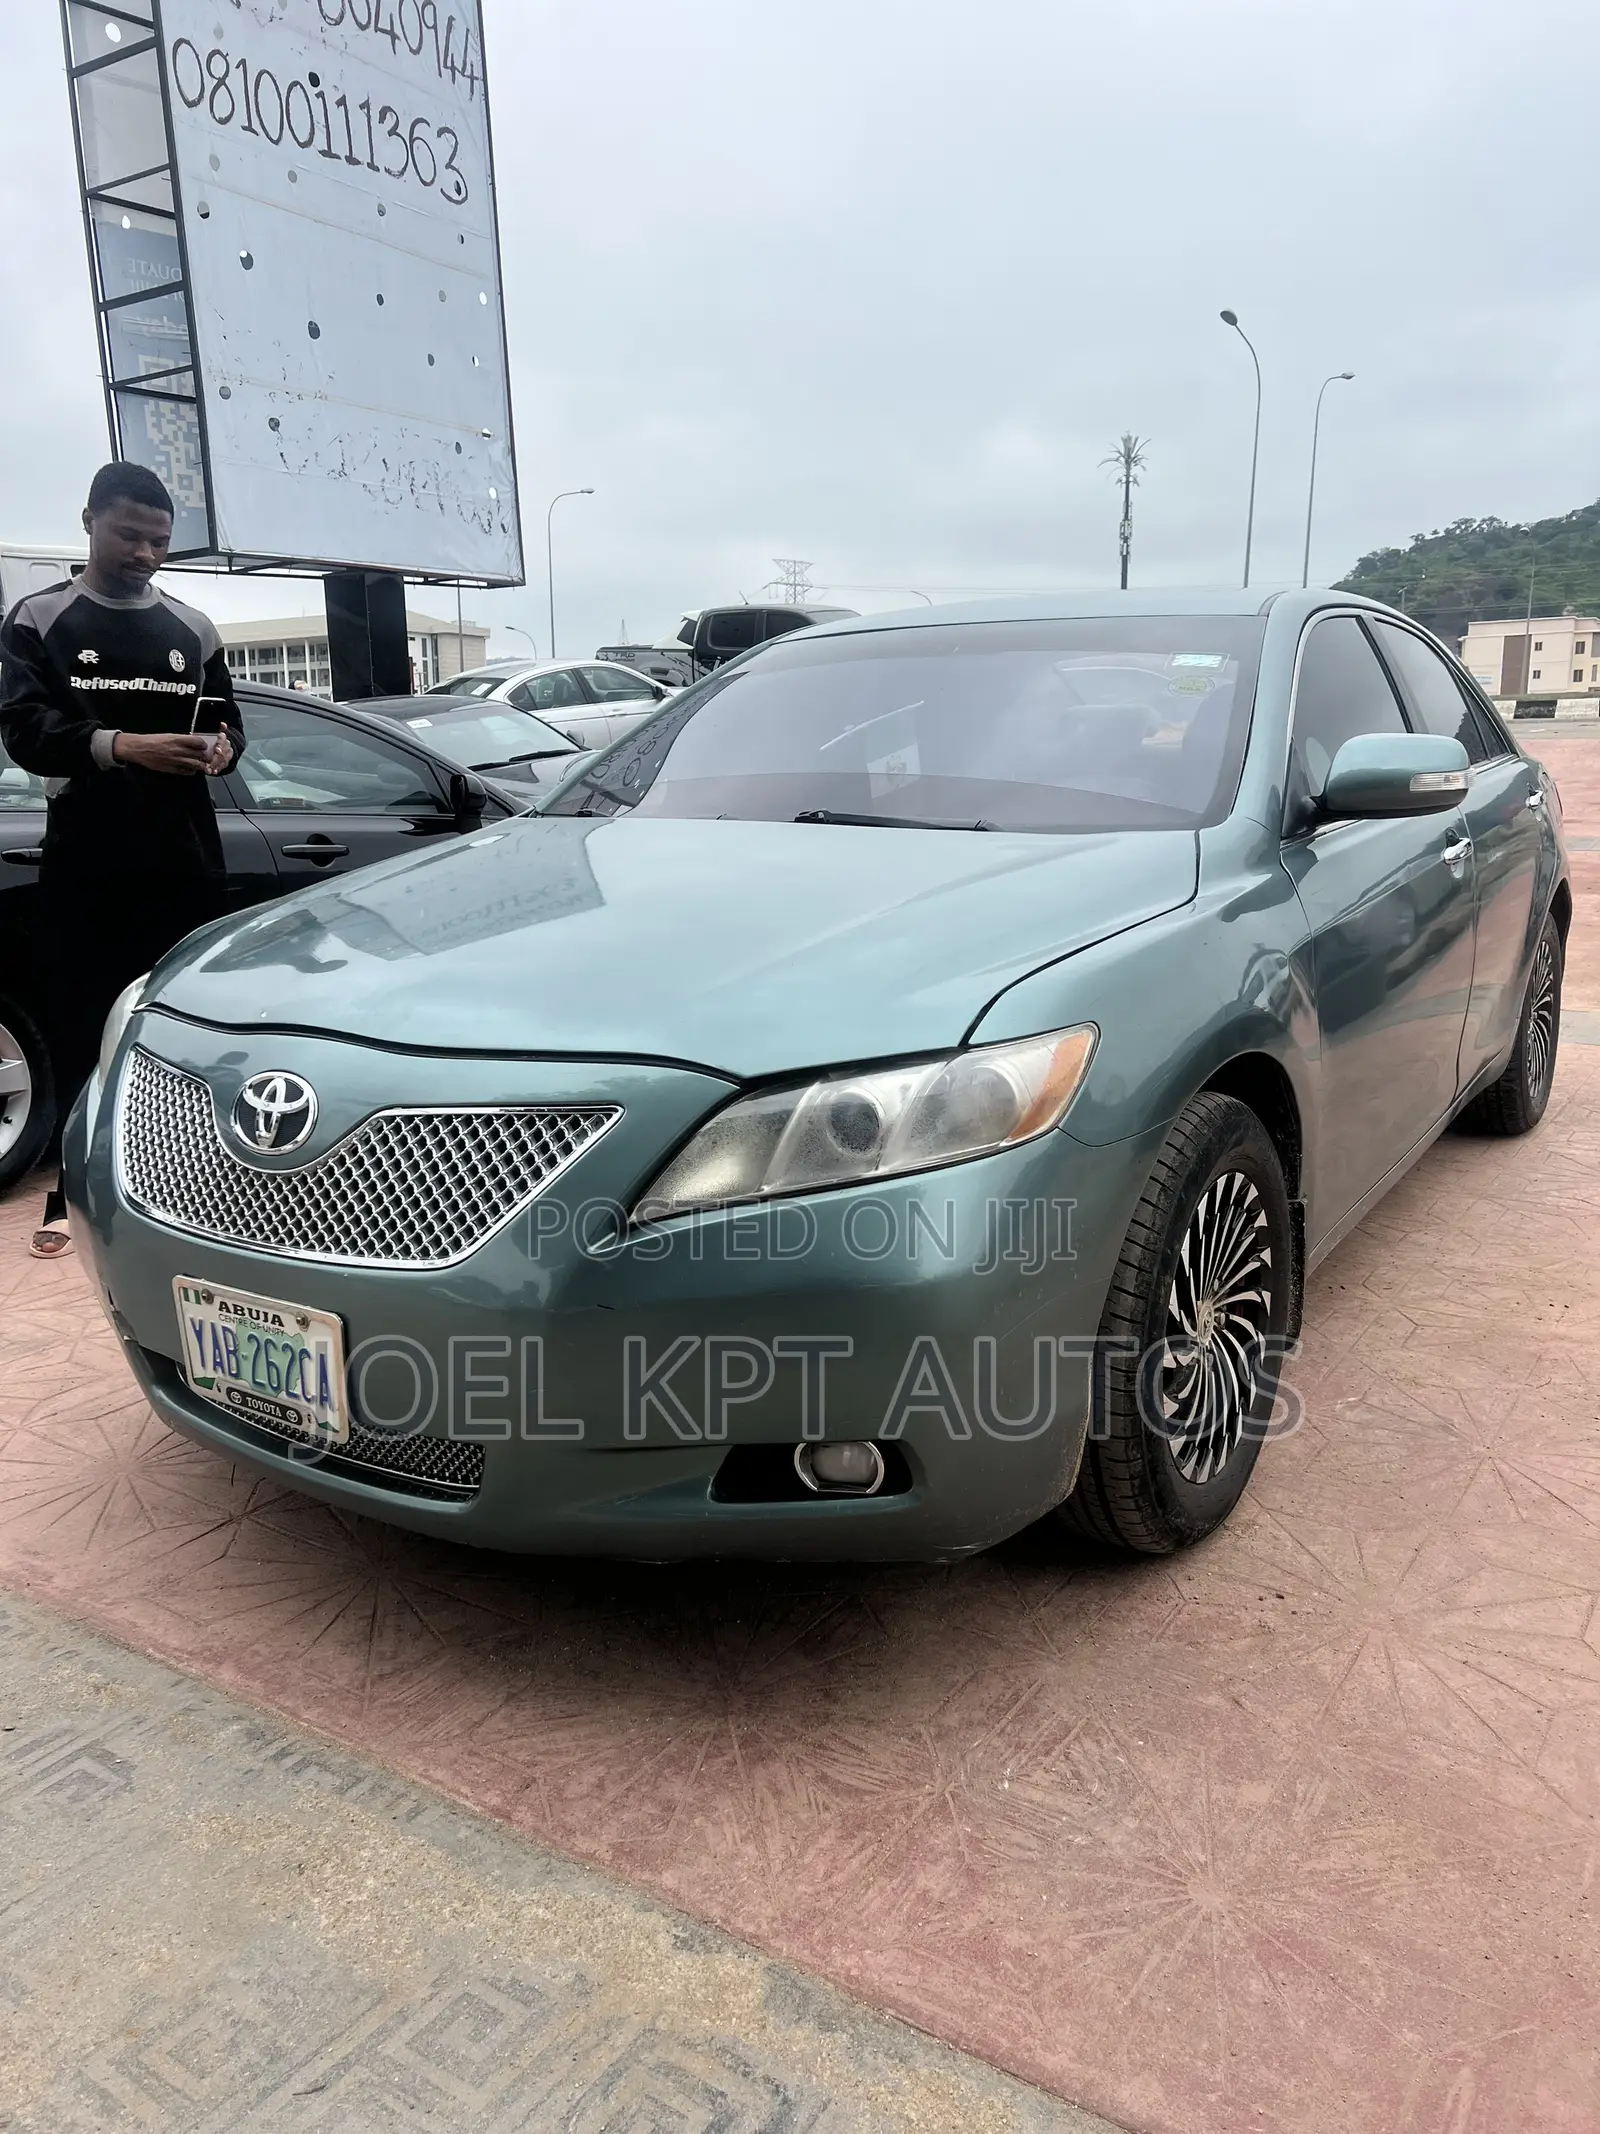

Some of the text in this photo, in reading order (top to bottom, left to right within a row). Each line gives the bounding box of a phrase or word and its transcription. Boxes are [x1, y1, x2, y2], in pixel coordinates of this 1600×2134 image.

[172, 37, 468, 205] 08100111363
[70, 675, 197, 696] RefusedChange
[218, 1301, 285, 1327] ABUJA
[218, 1313, 249, 1328] CENTRE
[246, 1396, 283, 1418] TOYOTA
